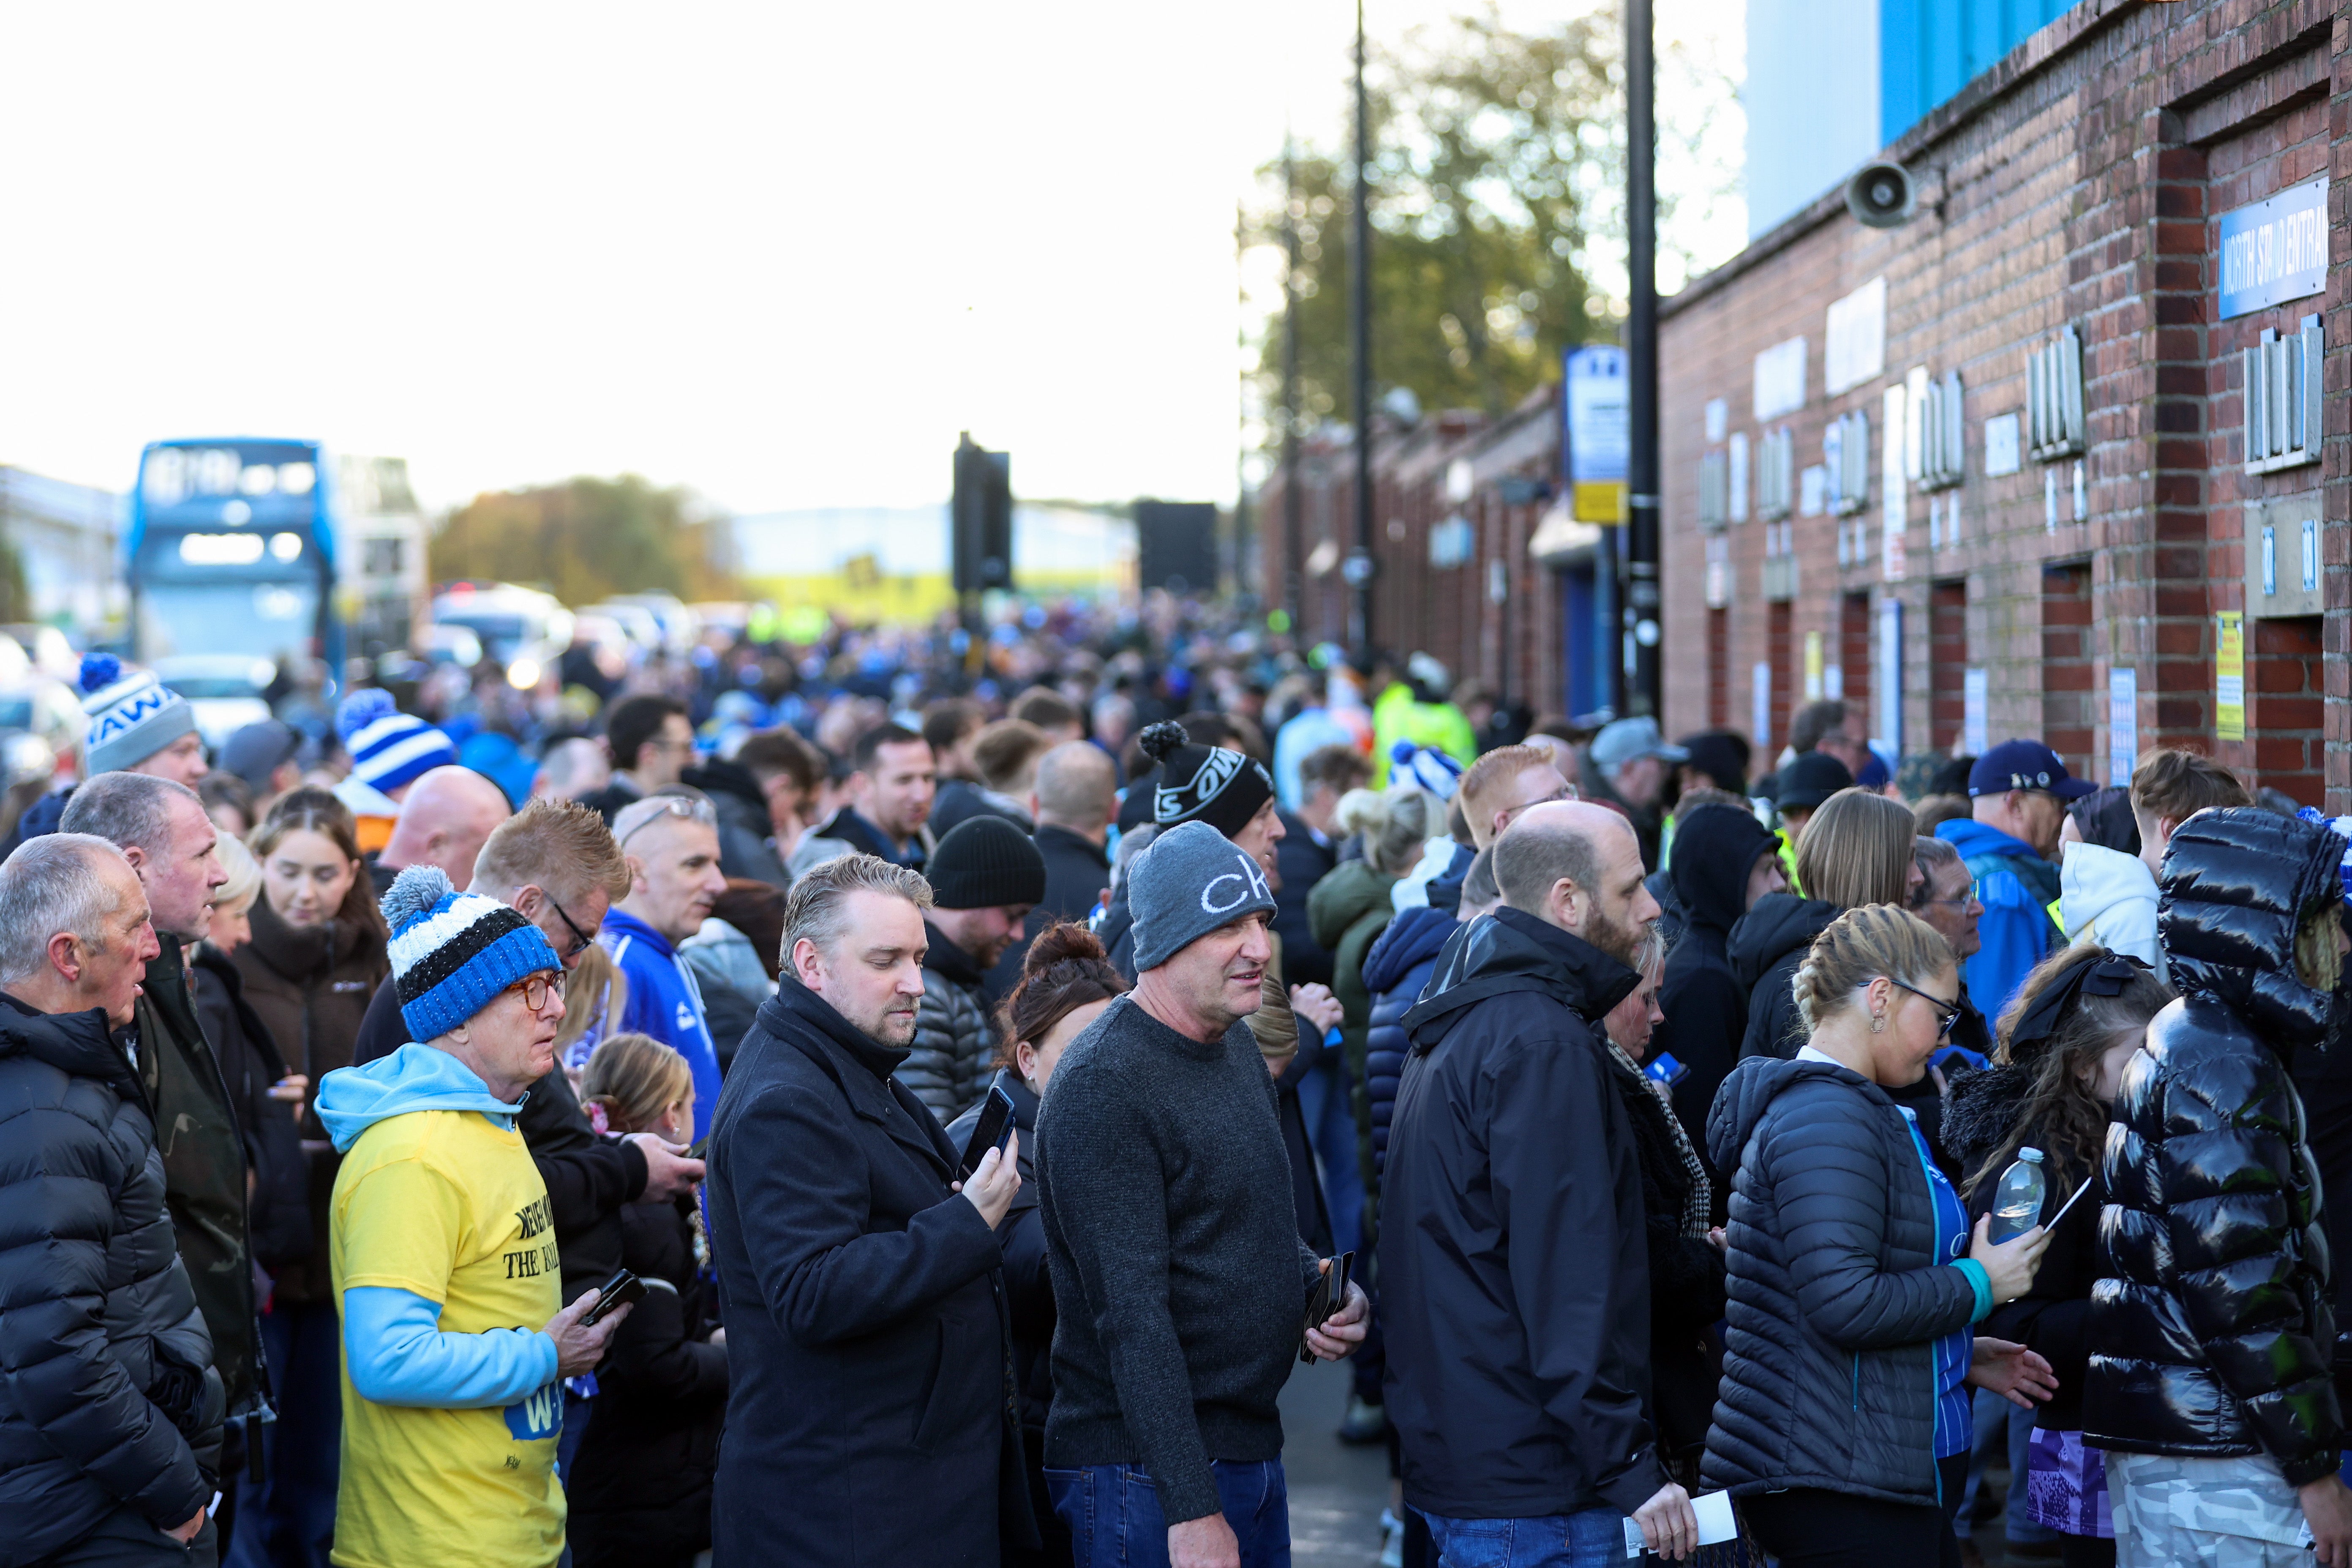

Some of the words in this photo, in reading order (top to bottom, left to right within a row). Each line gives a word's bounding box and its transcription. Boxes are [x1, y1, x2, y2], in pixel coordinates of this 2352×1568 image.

[2224, 229, 2255, 295] NORTH
[2257, 218, 2284, 286] STAND
[515, 1199, 546, 1239] NEVER
[503, 1249, 540, 1279] THE
